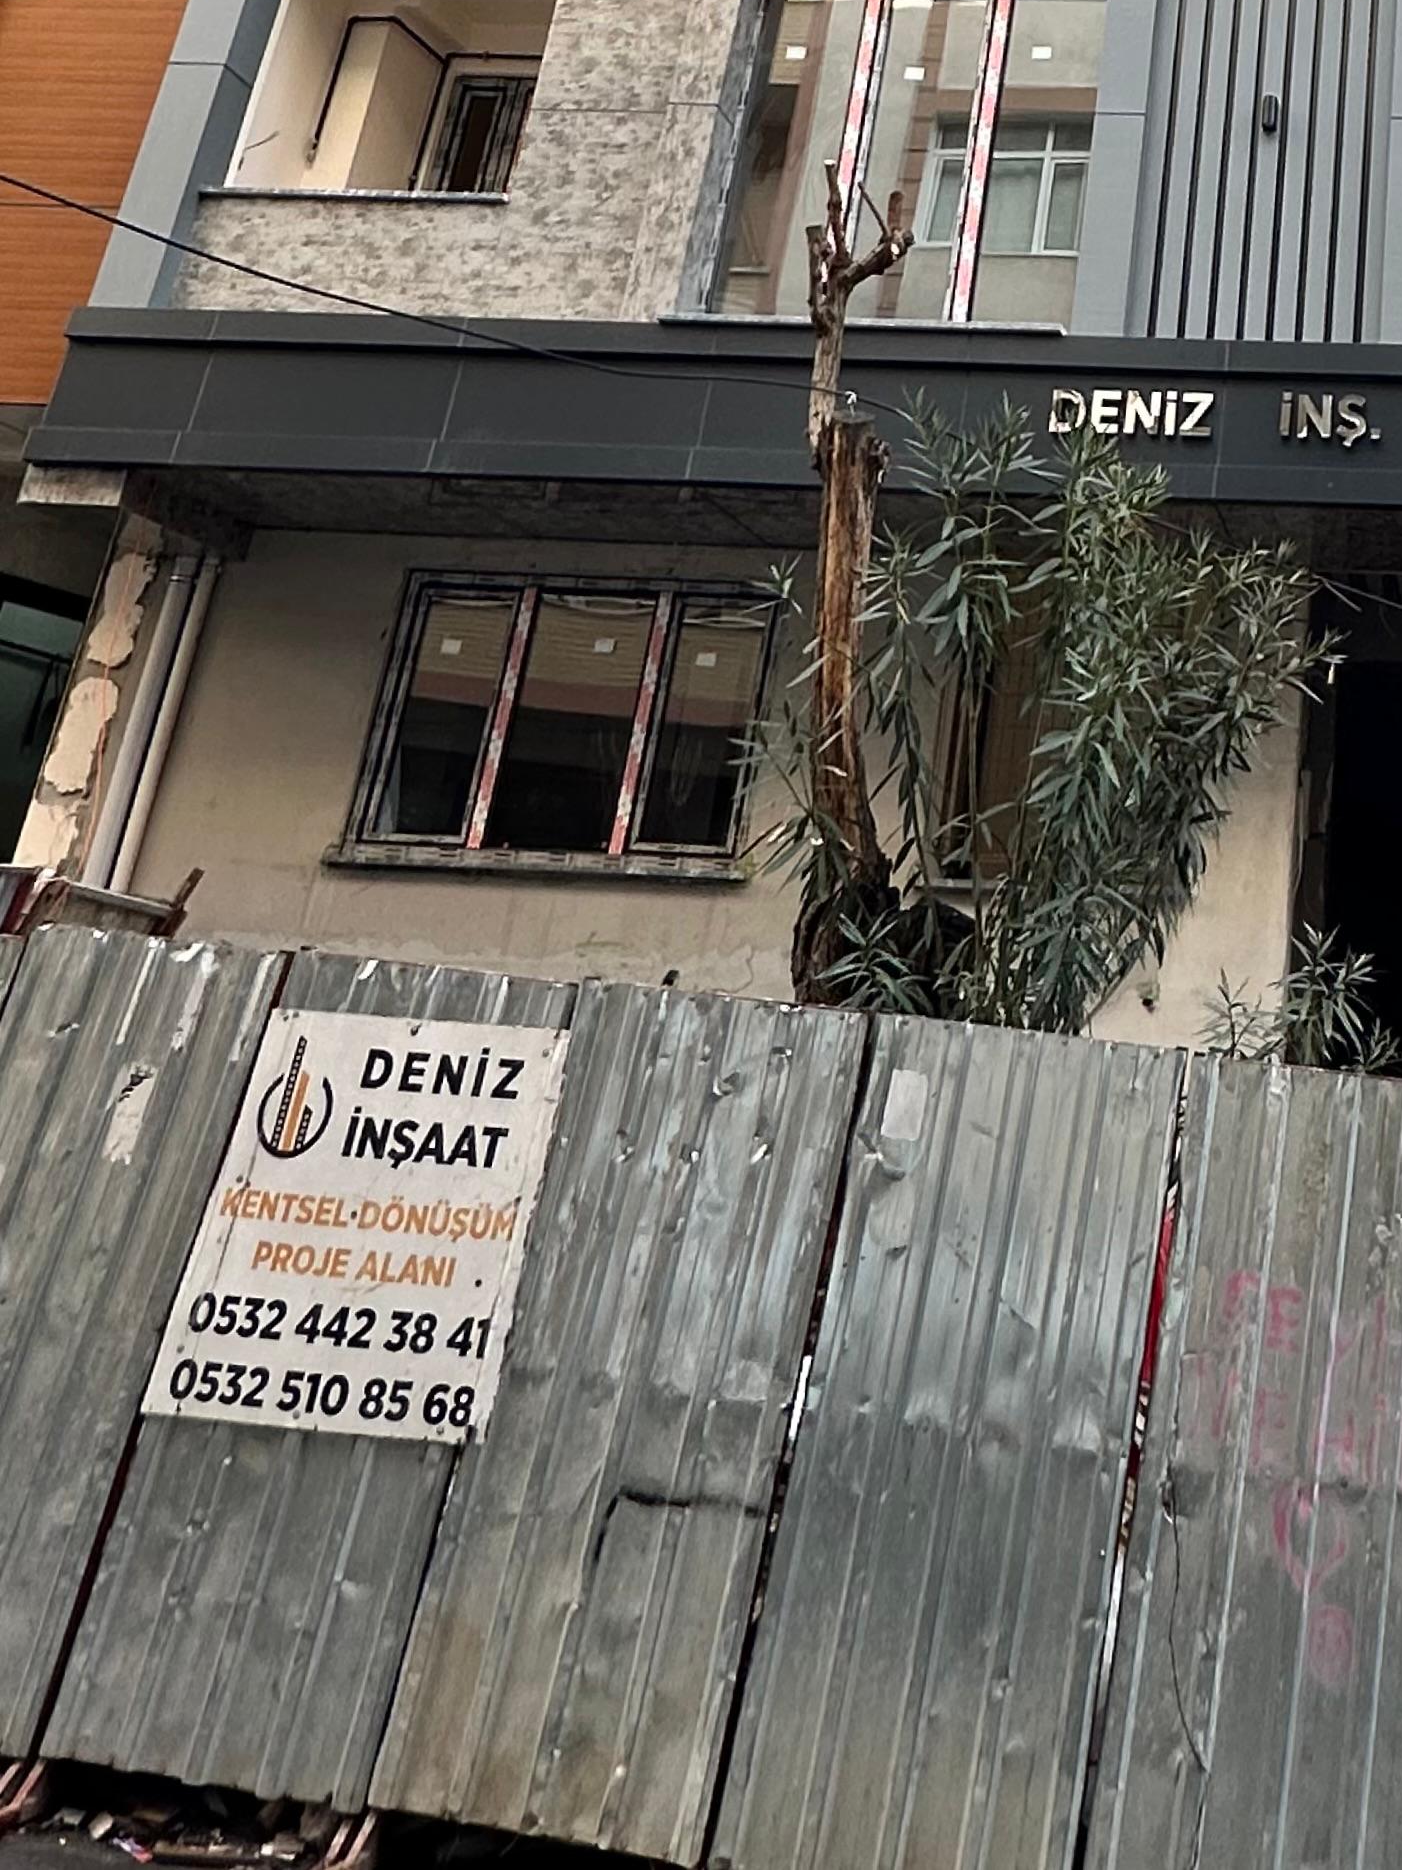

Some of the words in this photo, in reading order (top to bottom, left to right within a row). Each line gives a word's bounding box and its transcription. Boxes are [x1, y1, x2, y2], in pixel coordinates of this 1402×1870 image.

[360, 1047, 525, 1100] DENİZ
[341, 1106, 509, 1169] İNŞAAT
[220, 1187, 349, 1227] KENTSEL
[357, 1196, 518, 1242] DÖNÜŞÜM
[251, 1240, 351, 1279] PROJE
[355, 1249, 457, 1288] ALANI
[188, 1293, 288, 1340] 0532
[294, 1303, 377, 1349] 442
[383, 1312, 438, 1355] 38
[446, 1316, 494, 1360] 41
[169, 1358, 270, 1408] 0532
[276, 1370, 350, 1415] 510
[358, 1378, 414, 1422] 85
[422, 1383, 475, 1428] 68
